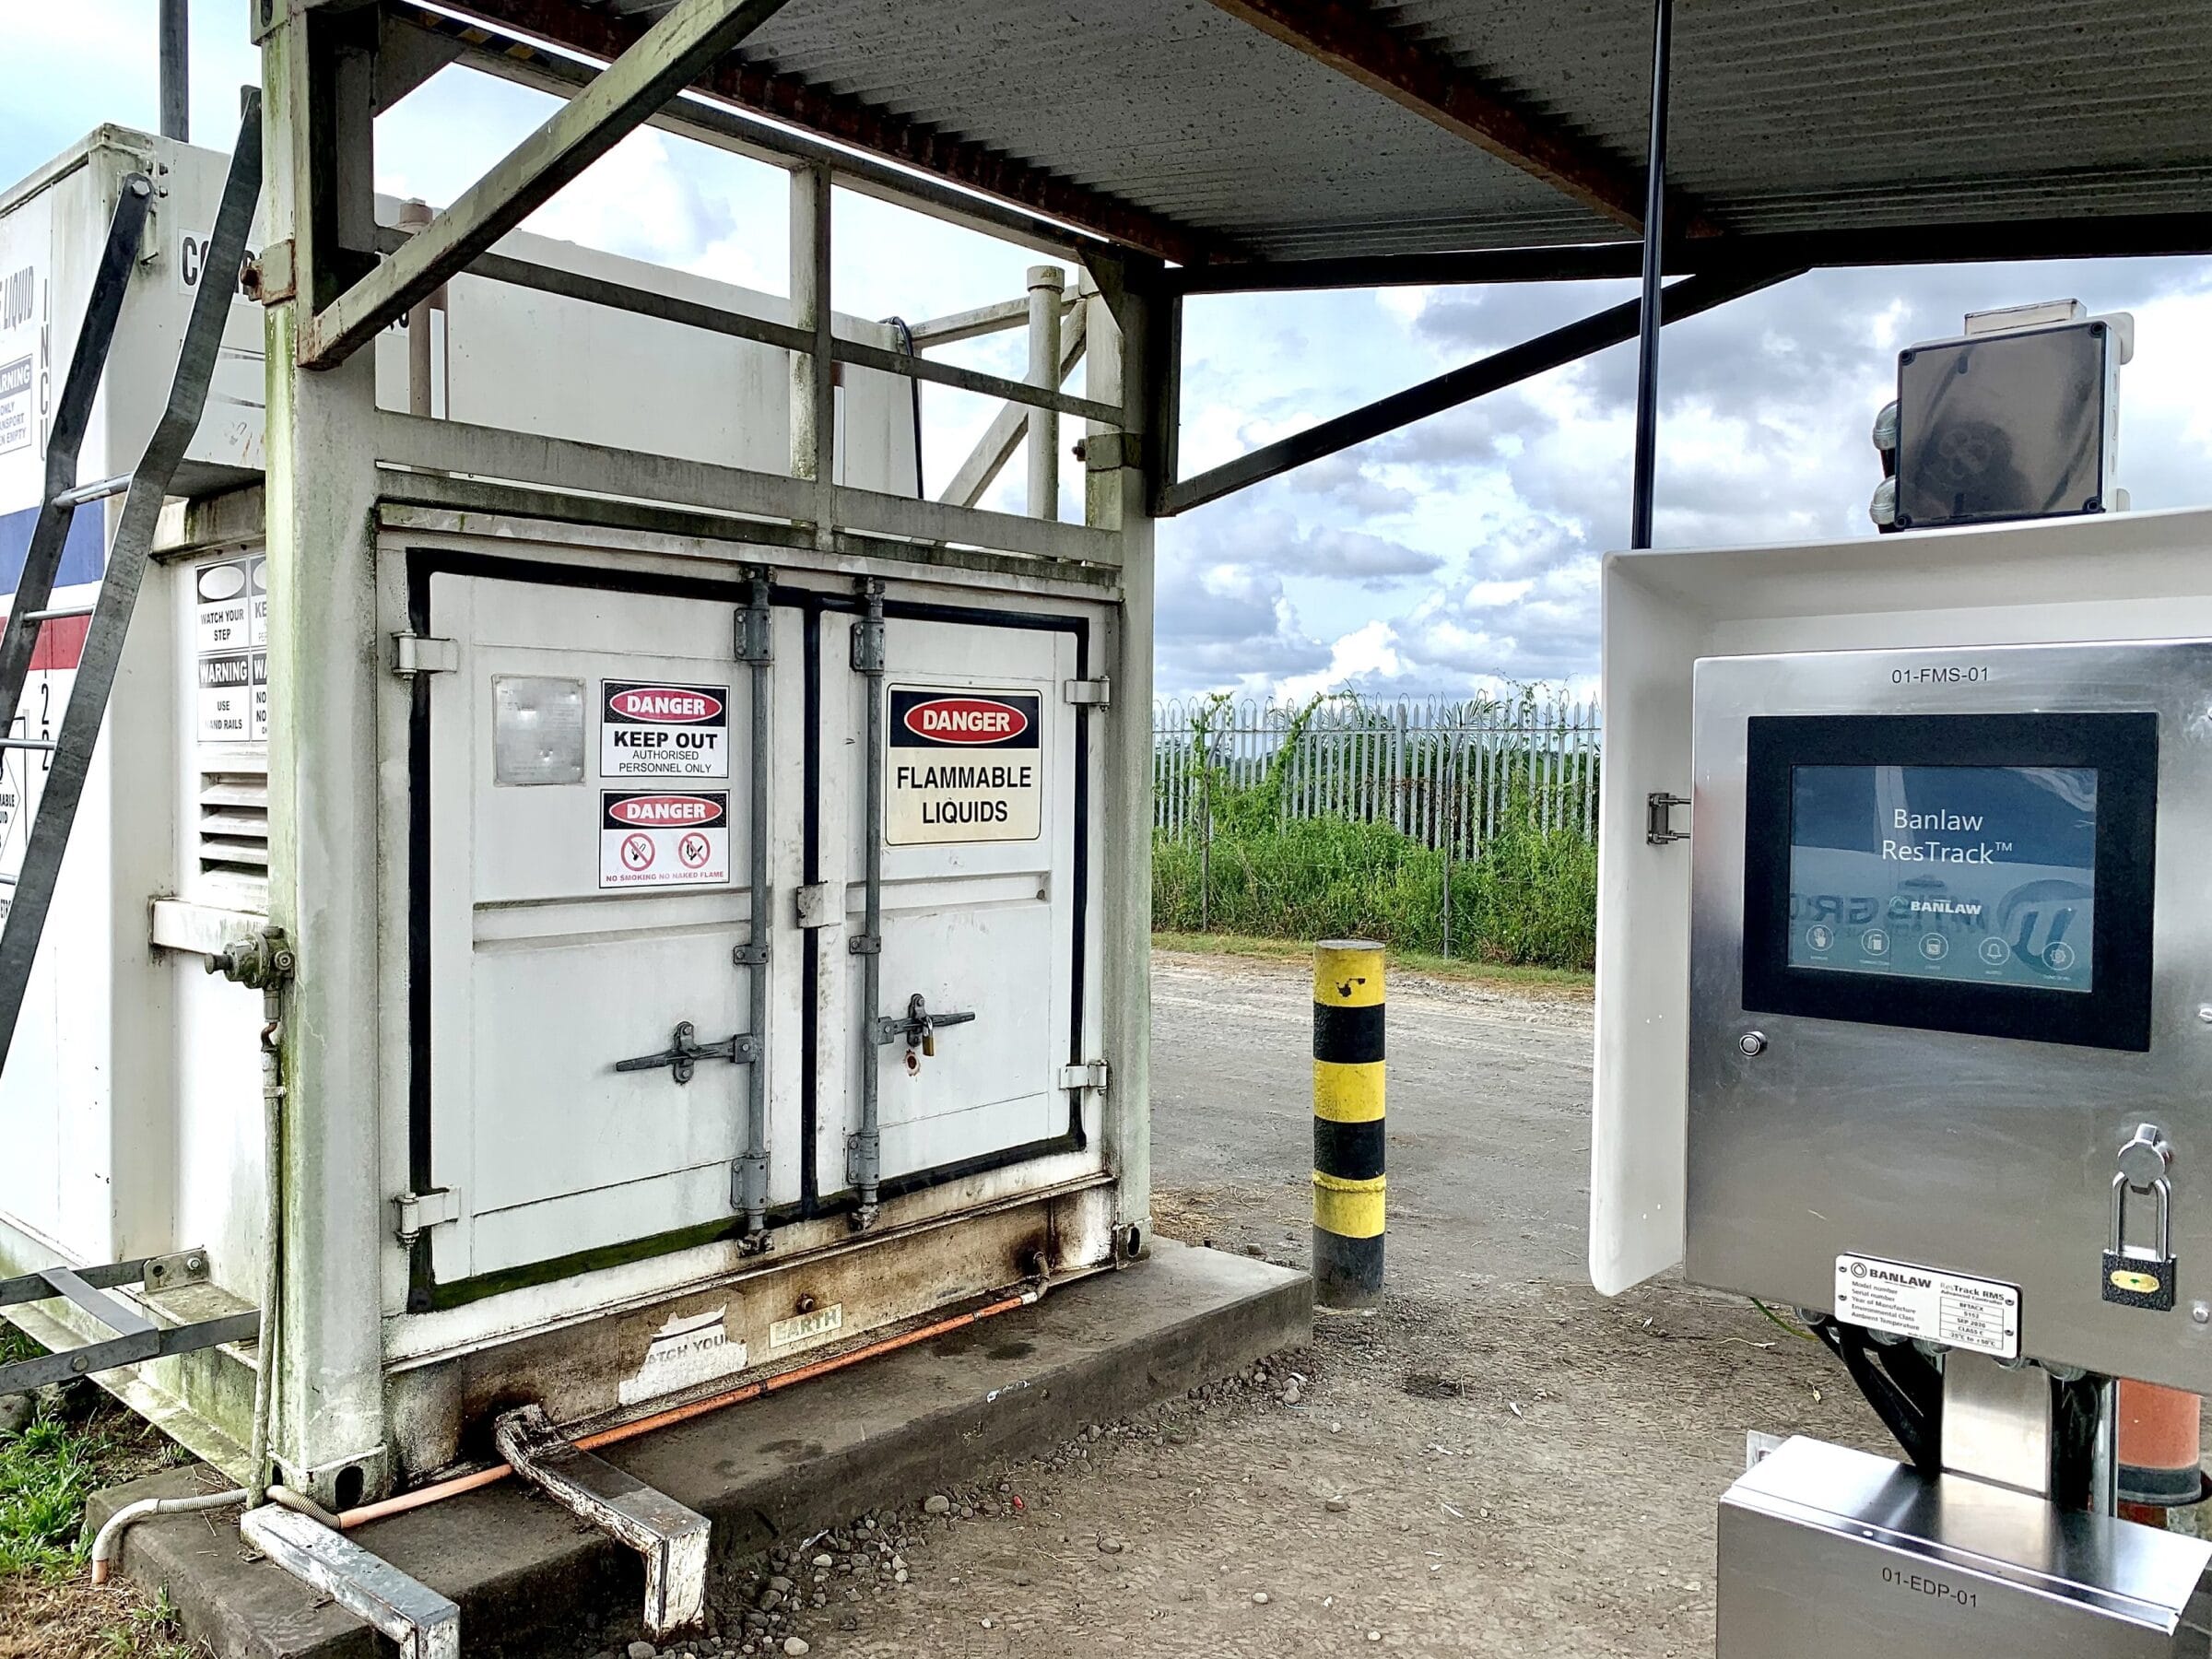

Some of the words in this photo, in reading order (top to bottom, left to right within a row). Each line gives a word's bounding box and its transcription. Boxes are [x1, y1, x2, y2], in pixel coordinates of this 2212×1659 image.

[3, 265, 34, 332] LIQUID
[0, 364, 30, 394] RNING
[0, 413, 25, 430] NSPORT
[201, 610, 224, 625] WATCH
[225, 608, 244, 622] YOUR
[254, 601, 267, 618] KE
[214, 629, 231, 641] STEP
[200, 661, 248, 684] WARNING
[1891, 666, 1989, 684] 01-FMS-01
[217, 700, 230, 711] USE
[256, 691, 267, 703] NO
[627, 695, 706, 715] DANGER
[224, 719, 242, 730] RAILS
[256, 710, 267, 722] NO
[923, 710, 1010, 733] DANGER
[614, 731, 669, 747] KEEP
[676, 733, 718, 749] OUT
[632, 750, 700, 760] AUTHORISED
[618, 762, 682, 772] PERSONNEL
[685, 763, 712, 773] ONLY
[897, 766, 1032, 790] FLAMMABLE
[0, 794, 15, 807] ABLE
[626, 802, 706, 819] DANGER
[922, 800, 1008, 824] LIQUIDS
[1894, 808, 1983, 831] Banlaw
[619, 873, 657, 882] SMOKING
[672, 871, 699, 879] NAKED
[700, 870, 724, 878] FLAME
[1911, 900, 1983, 915] BANLAW
[1869, 1268, 1932, 1288] BANLAW
[1940, 1282, 1980, 1296] ResTrack
[1983, 1290, 2005, 1300] RMS
[1875, 1300, 1916, 1314] Manufacture
[775, 1308, 838, 1341] EARTH
[648, 1344, 688, 1365] ATCH
[1882, 1567, 1977, 1608] 01-EDP-01
